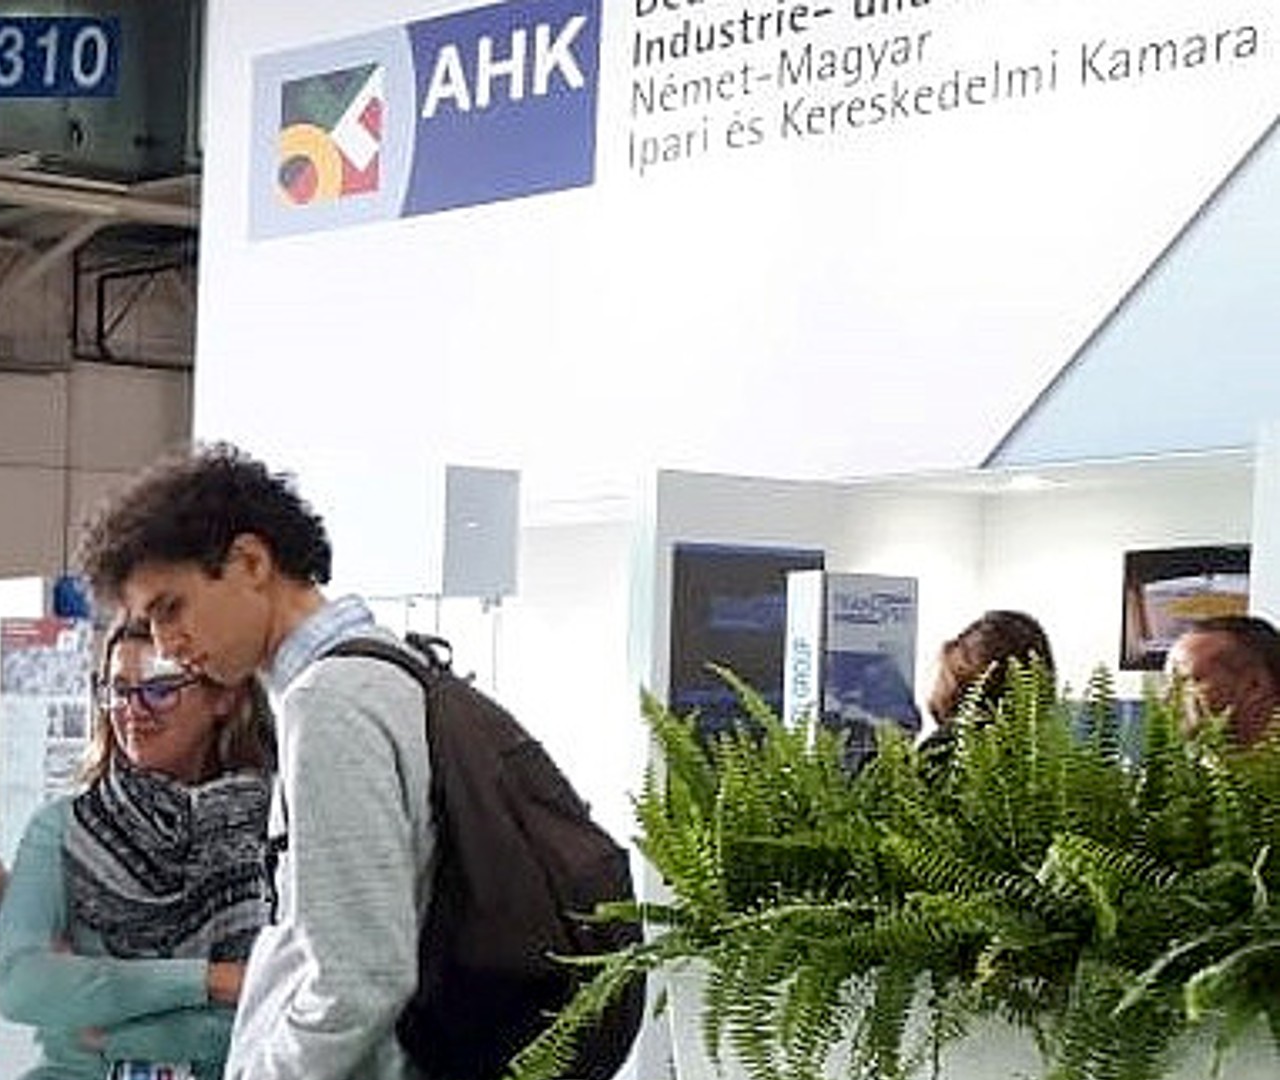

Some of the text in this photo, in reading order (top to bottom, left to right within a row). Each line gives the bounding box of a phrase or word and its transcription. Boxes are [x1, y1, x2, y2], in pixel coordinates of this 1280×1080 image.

[421, 17, 587, 119] AHK
[631, 31, 934, 118] Német-Magyar
[633, 0, 834, 67] Industrie-
[628, 25, 1259, 177] Ipari és Kereskedelmi Kamara
